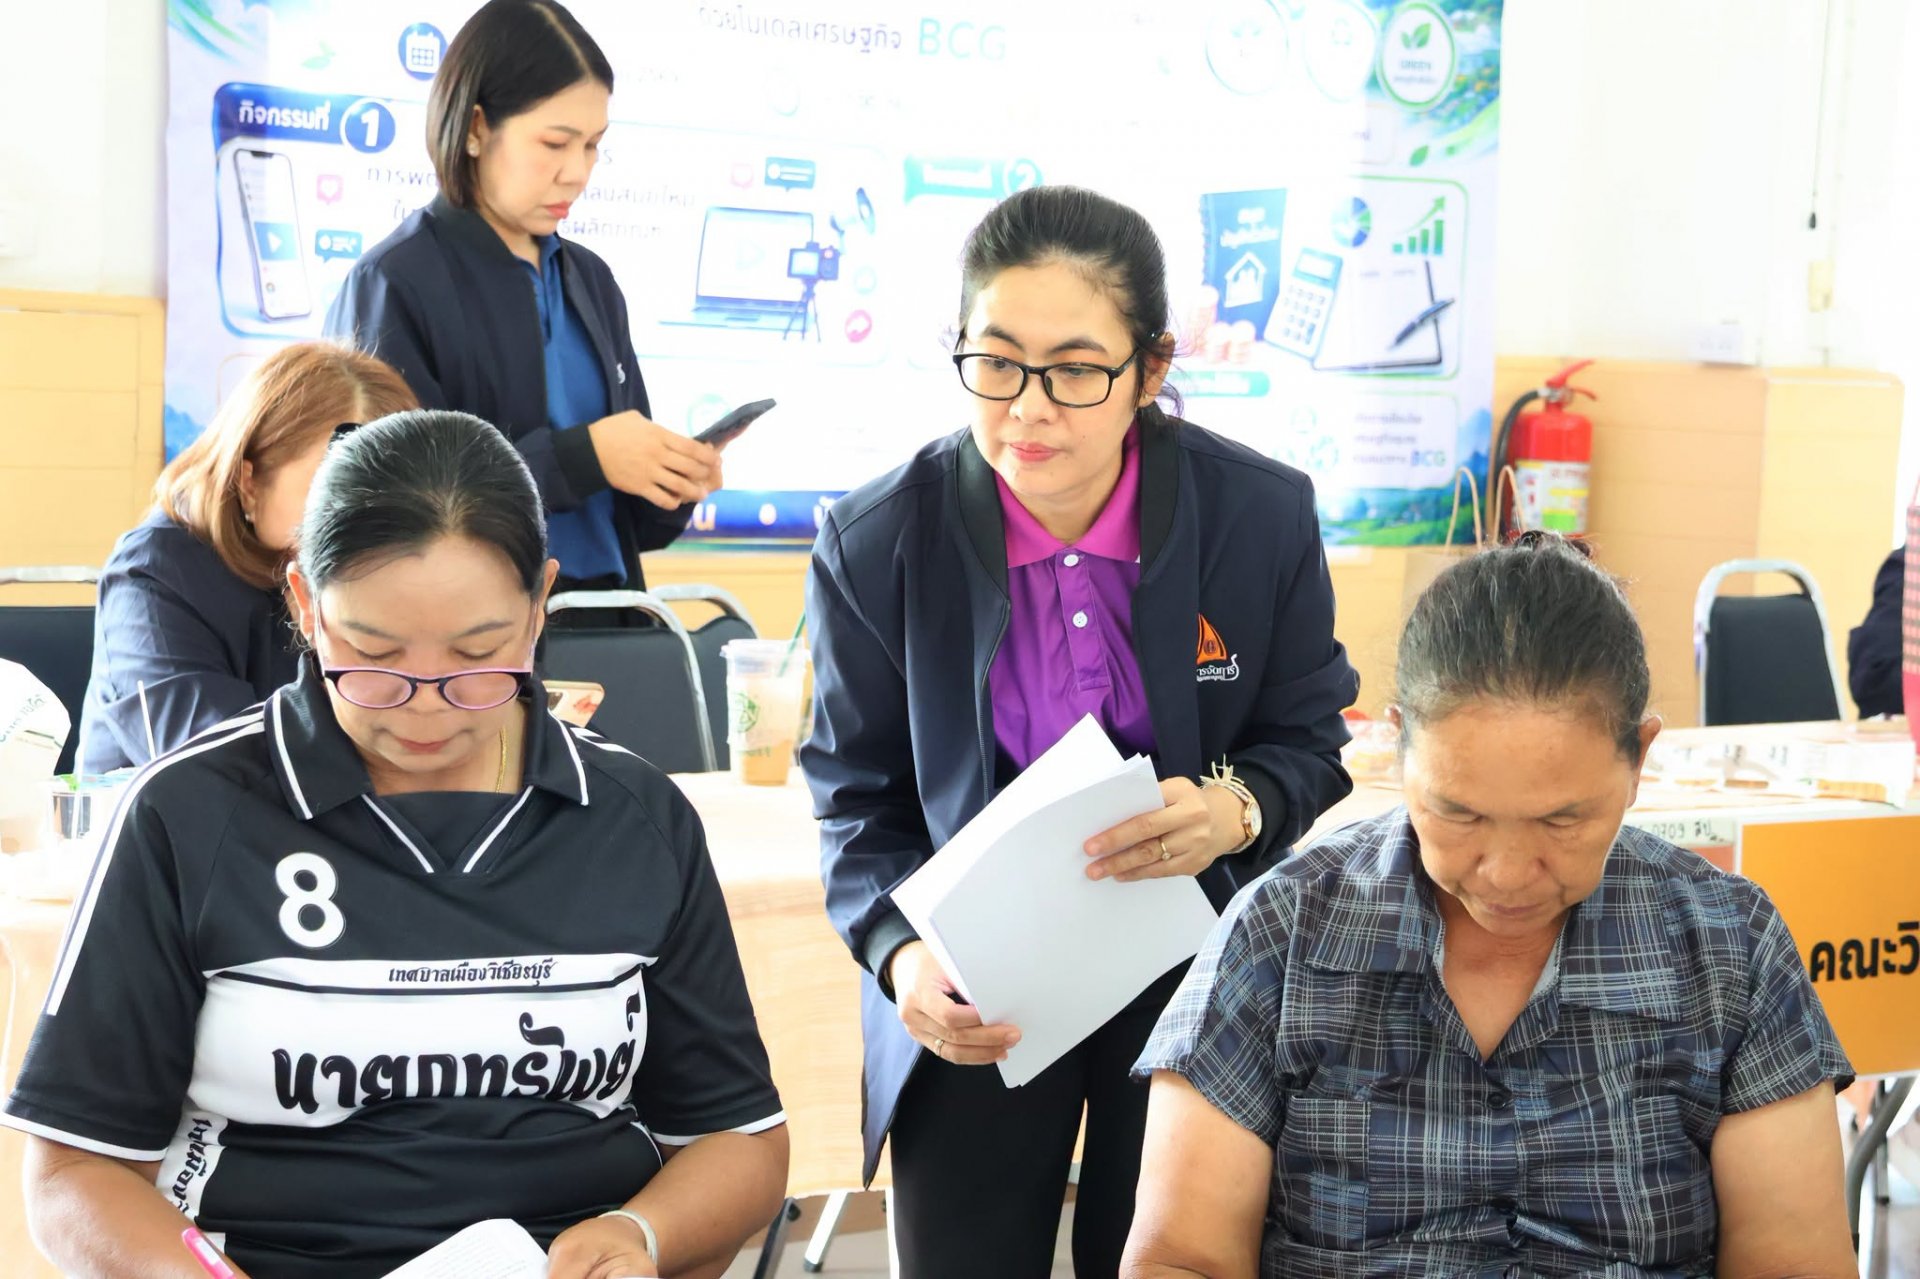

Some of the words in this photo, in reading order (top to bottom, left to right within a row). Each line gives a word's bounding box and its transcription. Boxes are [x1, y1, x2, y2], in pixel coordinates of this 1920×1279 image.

[918, 16, 1007, 61] BCG
[239, 99, 331, 131] กิจกรรมที่
[360, 108, 380, 147] 1
[274, 851, 346, 949] 8
[388, 957, 558, 987] เทศบาลเมืองวิเชียรบุรี
